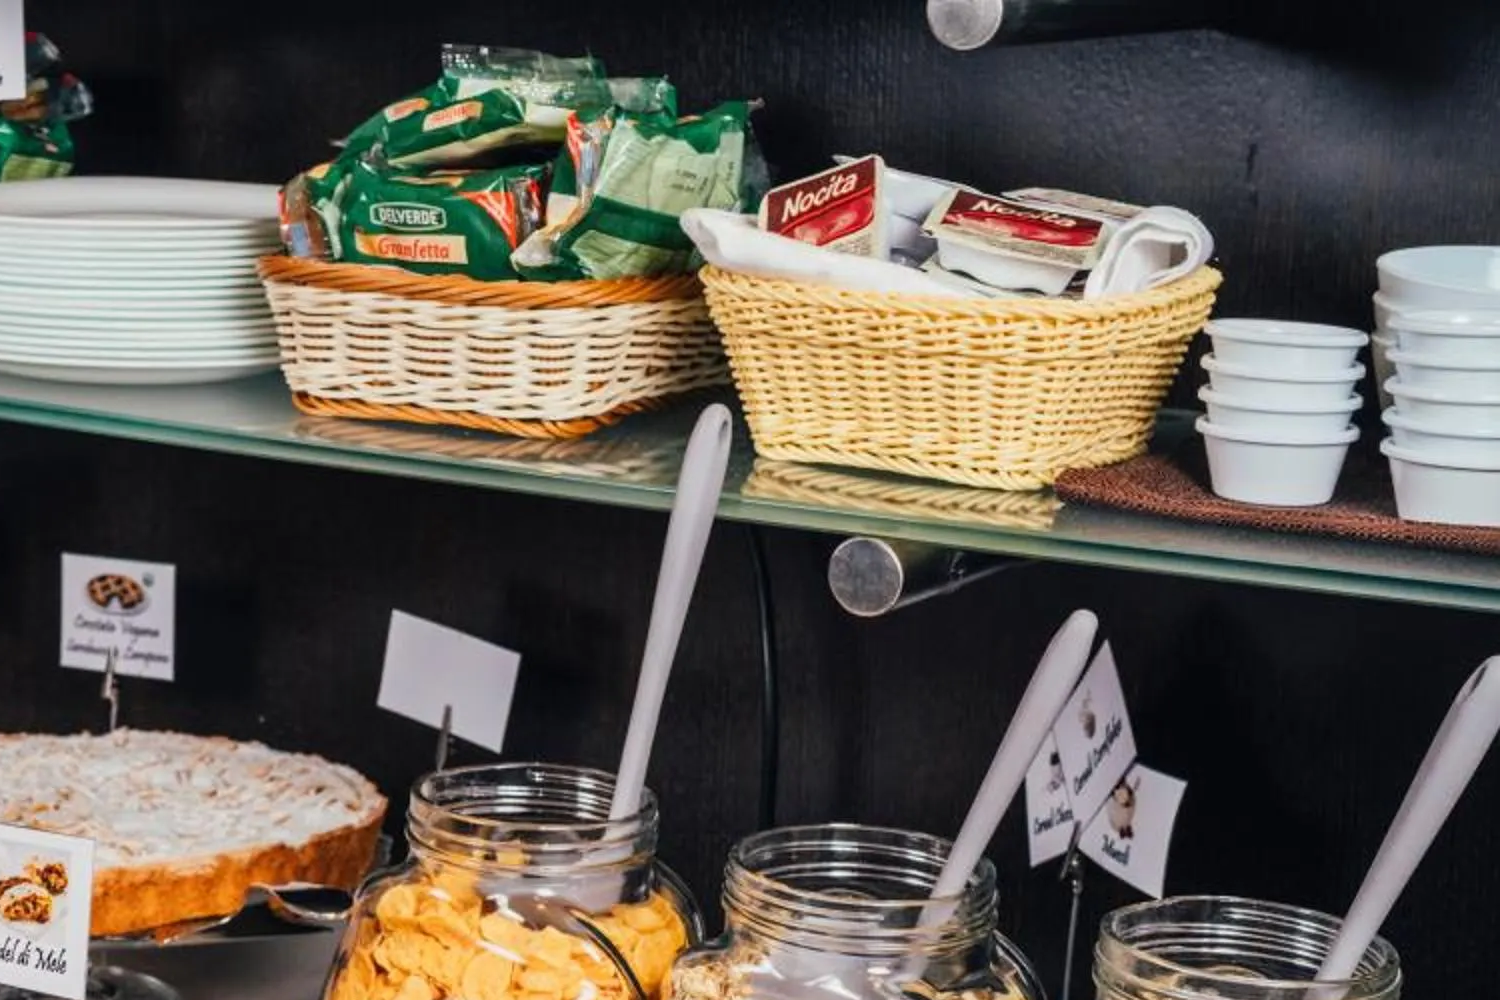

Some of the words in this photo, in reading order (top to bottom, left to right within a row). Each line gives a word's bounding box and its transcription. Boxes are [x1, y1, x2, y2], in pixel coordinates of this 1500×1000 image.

[781, 172, 858, 223] Nocita
[378, 207, 440, 225] DELVERDE
[377, 237, 450, 260] Granfetta
[16, 940, 32, 967] di
[35, 948, 67, 975] Mele
